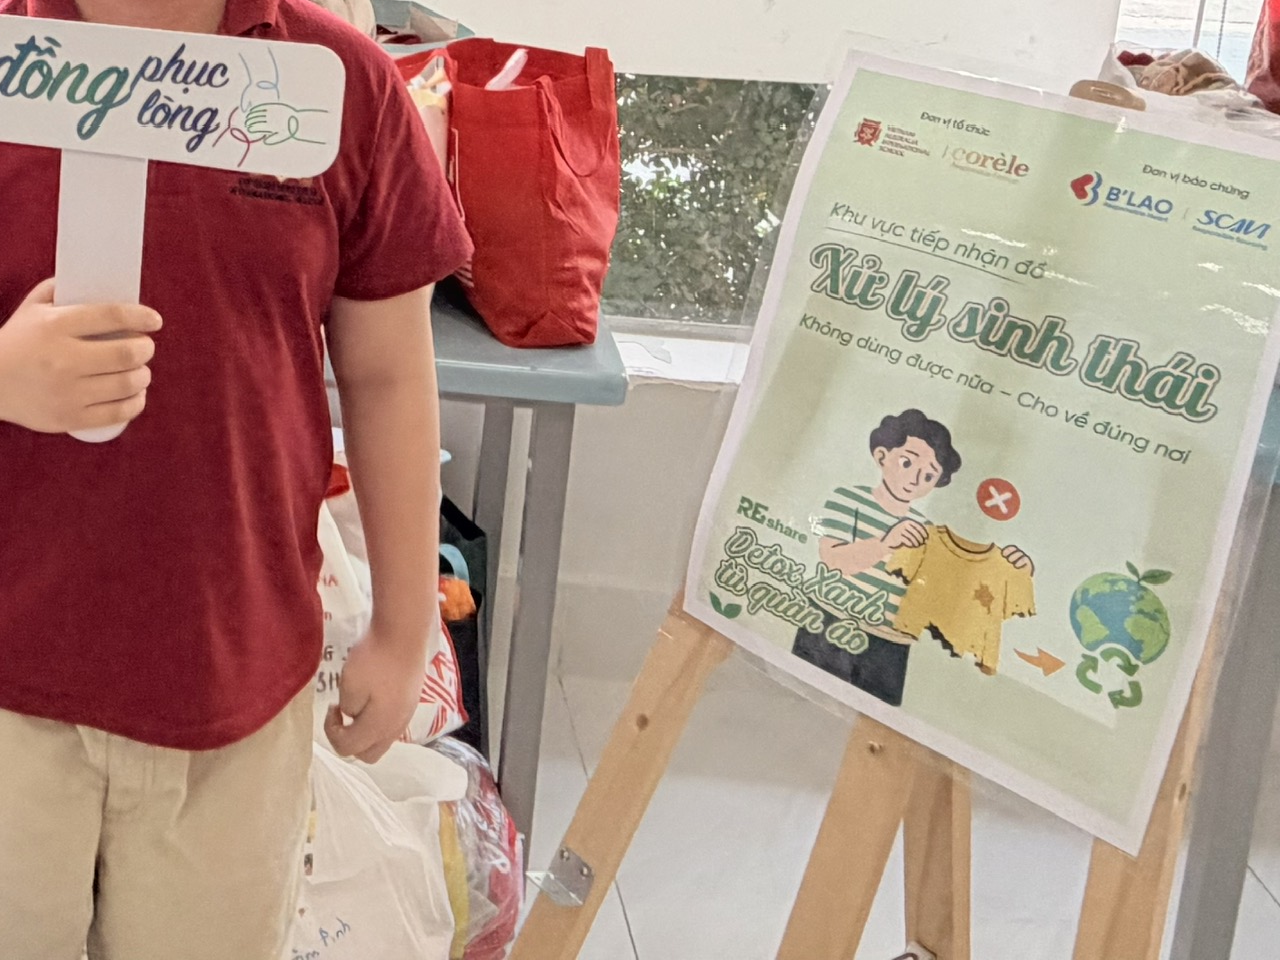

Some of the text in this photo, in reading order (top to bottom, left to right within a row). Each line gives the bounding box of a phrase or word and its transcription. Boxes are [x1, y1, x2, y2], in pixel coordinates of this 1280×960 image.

[131, 43, 231, 95] phục
[136, 89, 222, 153] lòng
[951, 147, 1030, 178] corèle
[1142, 164, 1167, 178] Đơn
[1169, 171, 1181, 184] vị
[830, 202, 867, 226] Khu
[870, 216, 905, 237] vực
[909, 226, 950, 252] tiếp
[953, 243, 1010, 270] nhận
[809, 243, 1222, 425] Xử lý sinh thái
[799, 313, 854, 346] Không
[856, 336, 903, 365] dùng
[906, 353, 954, 380] được
[956, 373, 995, 395] nữa
[1017, 391, 1059, 418] Cho
[1065, 411, 1091, 429] về
[1093, 421, 1151, 454] đúng
[1153, 442, 1192, 465] nơi
[725, 526, 889, 626] Detox Xanh
[746, 581, 825, 634] quần
[825, 618, 870, 655] áo
